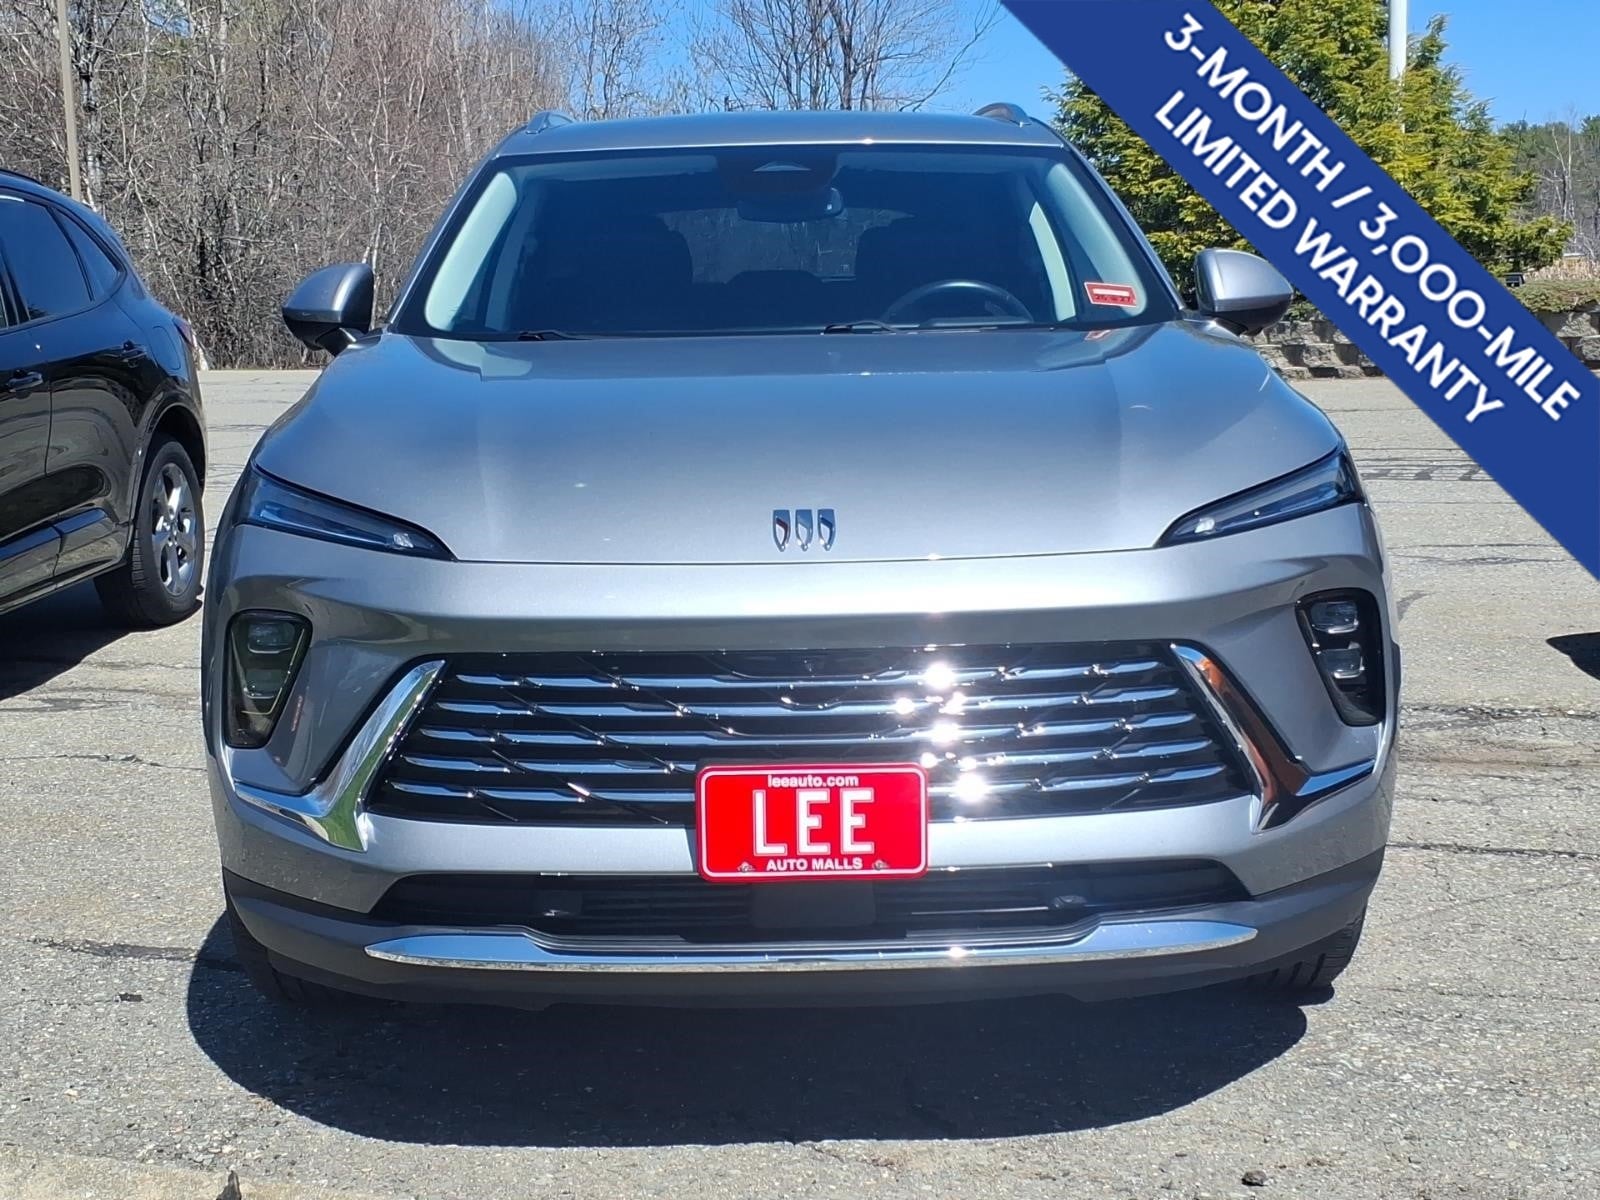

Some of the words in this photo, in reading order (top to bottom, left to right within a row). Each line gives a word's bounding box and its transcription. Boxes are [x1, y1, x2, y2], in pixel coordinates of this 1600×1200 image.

[767, 774, 859, 787] leeauto.com
[753, 787, 875, 857] LEE
[766, 858, 808, 871] AUTO
[811, 857, 863, 870] MALLS
